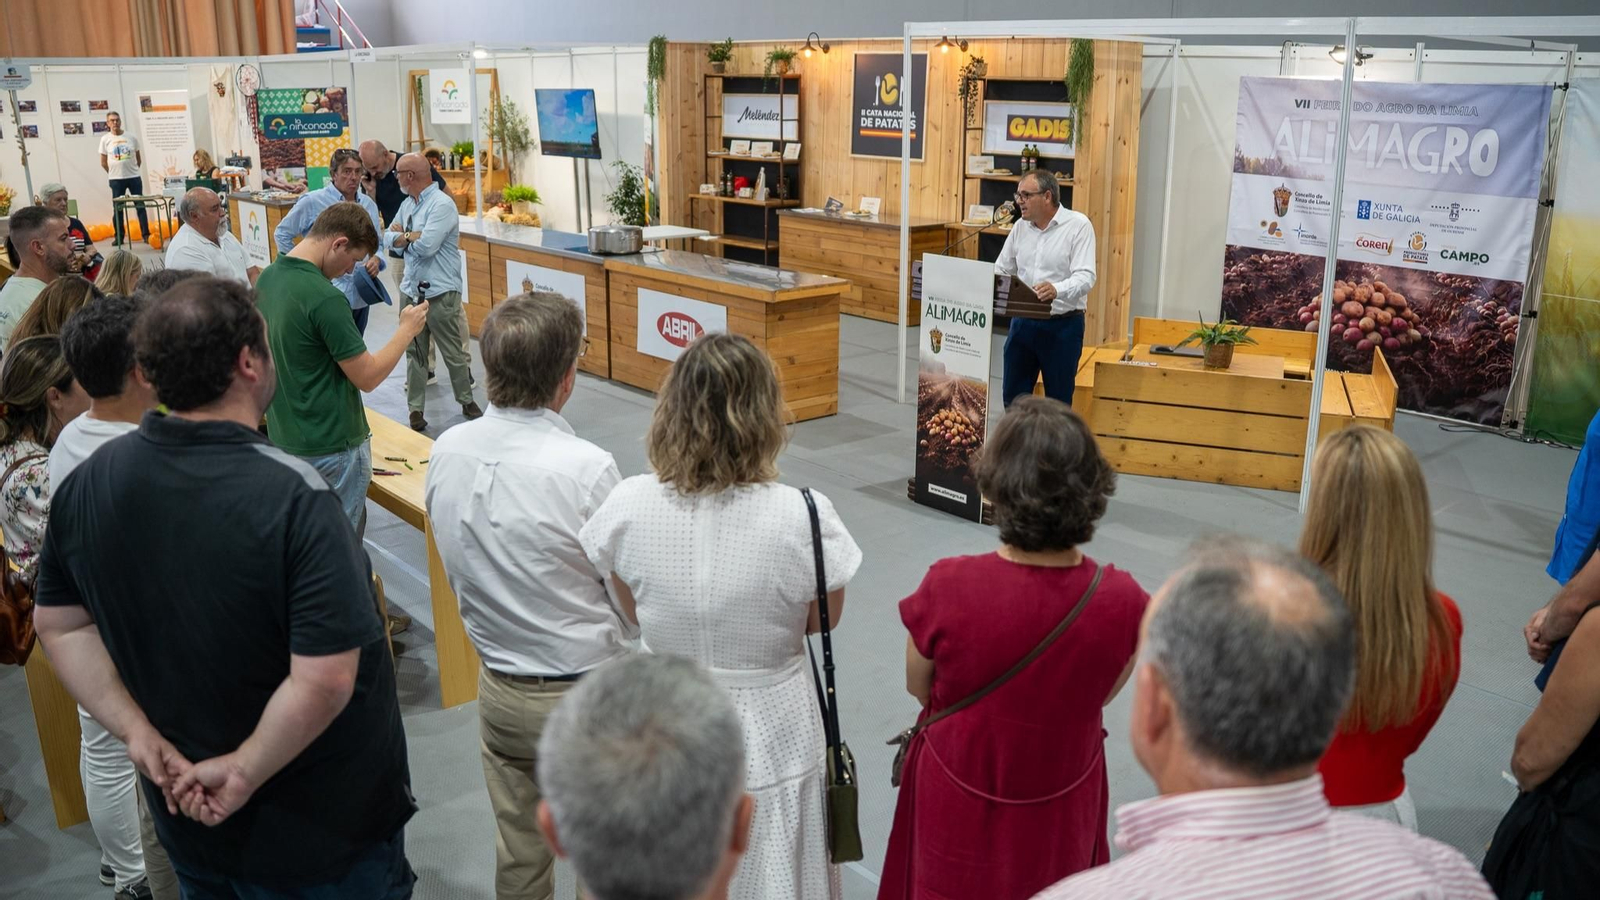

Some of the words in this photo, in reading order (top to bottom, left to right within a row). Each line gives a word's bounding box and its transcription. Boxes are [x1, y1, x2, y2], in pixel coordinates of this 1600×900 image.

[866, 109, 882, 117] CATA
[1294, 98, 1311, 109] VII
[1314, 99, 1342, 111] FEIR
[1353, 101, 1373, 113] DO
[1376, 102, 1414, 114] AGRO
[1416, 104, 1437, 115] DA
[1440, 105, 1479, 117] LIMIA
[860, 117, 873, 127] DE
[875, 118, 917, 130] PATATS
[1009, 116, 1071, 139] GADIS
[1294, 191, 1315, 199] Concello
[1374, 203, 1403, 213] XUNTA
[1372, 213, 1383, 221] DE
[1386, 214, 1421, 224] GALICIA
[1440, 249, 1490, 264] CAMPO
